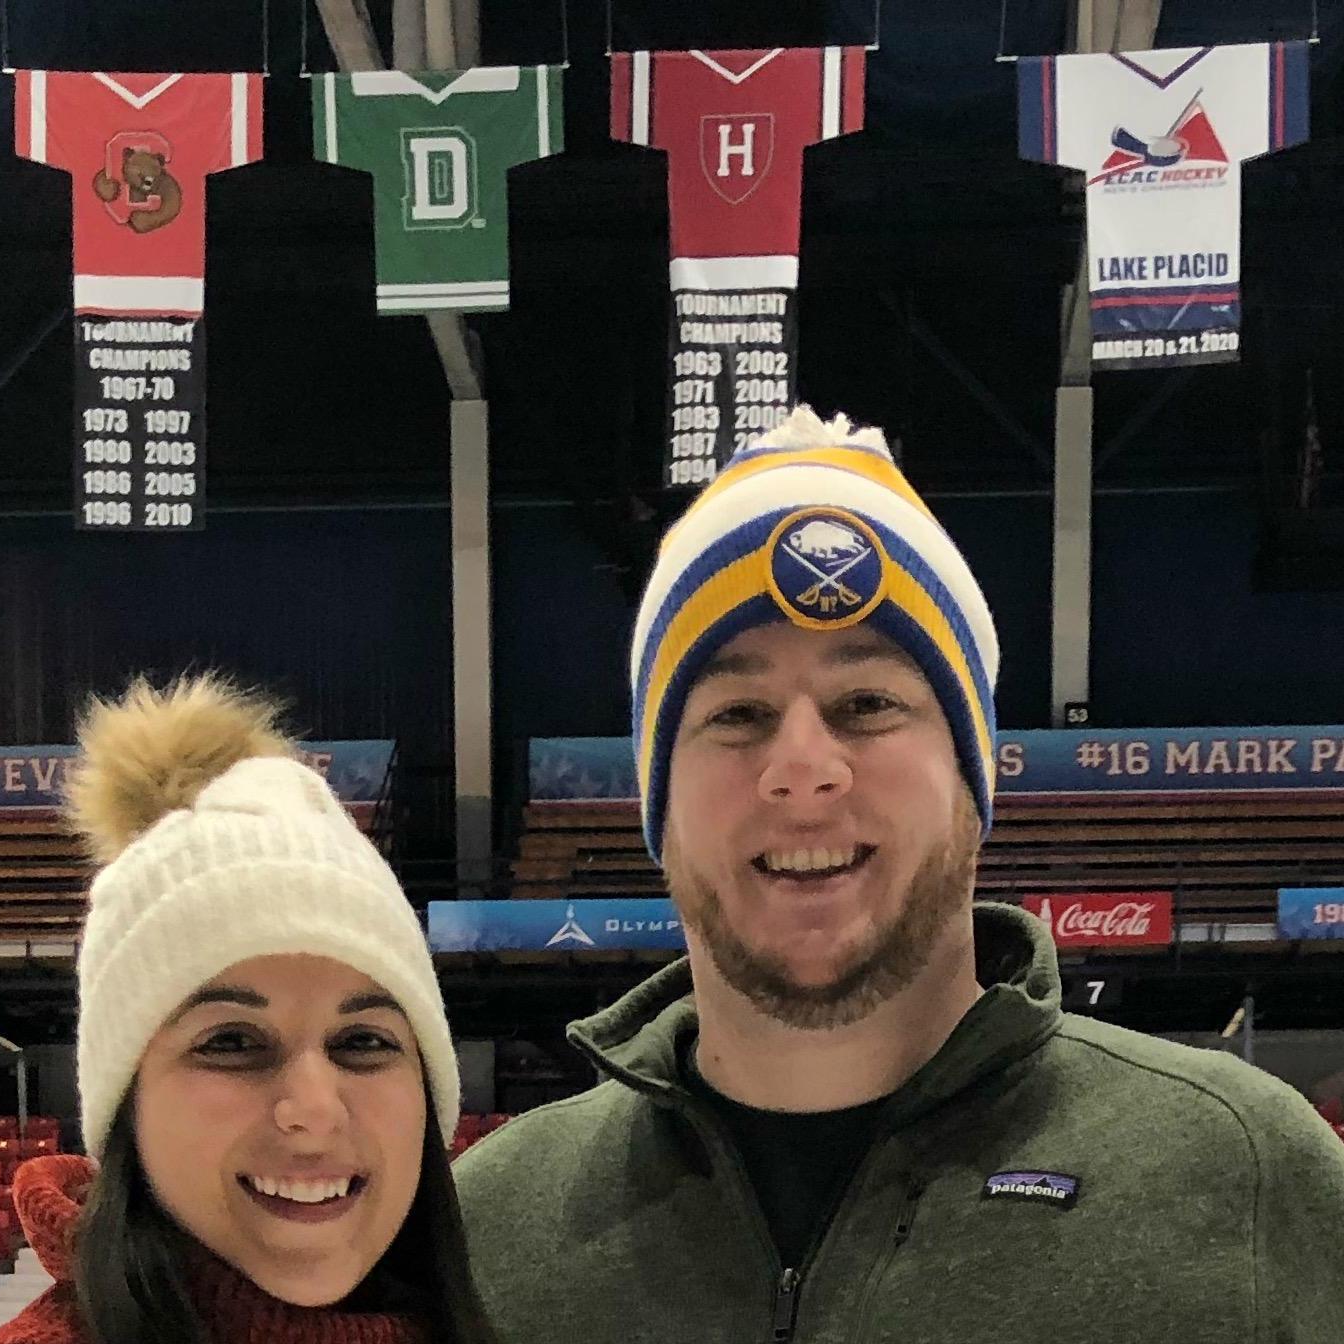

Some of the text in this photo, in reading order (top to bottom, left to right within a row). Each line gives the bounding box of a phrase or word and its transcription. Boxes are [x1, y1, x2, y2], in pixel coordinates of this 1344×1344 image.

[717, 123, 755, 177] H
[400, 126, 478, 231] D
[1160, 167, 1229, 182] HOCKEY
[1098, 253, 1229, 282] LAKE PLACID
[675, 293, 788, 317] TOURNAMENT
[81, 321, 194, 343] TOURNAMENT
[680, 321, 783, 344] CHAMPIONS
[1200, 331, 1240, 353] 2020
[89, 348, 191, 371] CHAMPIONS
[673, 350, 789, 377] 1963 2002
[99, 375, 175, 401] 1967-70
[673, 379, 789, 404] 1971 2004
[82, 408, 191, 434] 1973 1997
[144, 441, 196, 465] 2003
[144, 472, 197, 497] 2005
[144, 503, 193, 527] 2010
[1067, 708, 1088, 723] 53
[1075, 741, 1151, 777] #16
[1164, 738, 1298, 775] MARK
[605, 918, 688, 933] OLYMP
[1086, 980, 1106, 1006] 7
[990, 1182, 1068, 1200] patagonia
